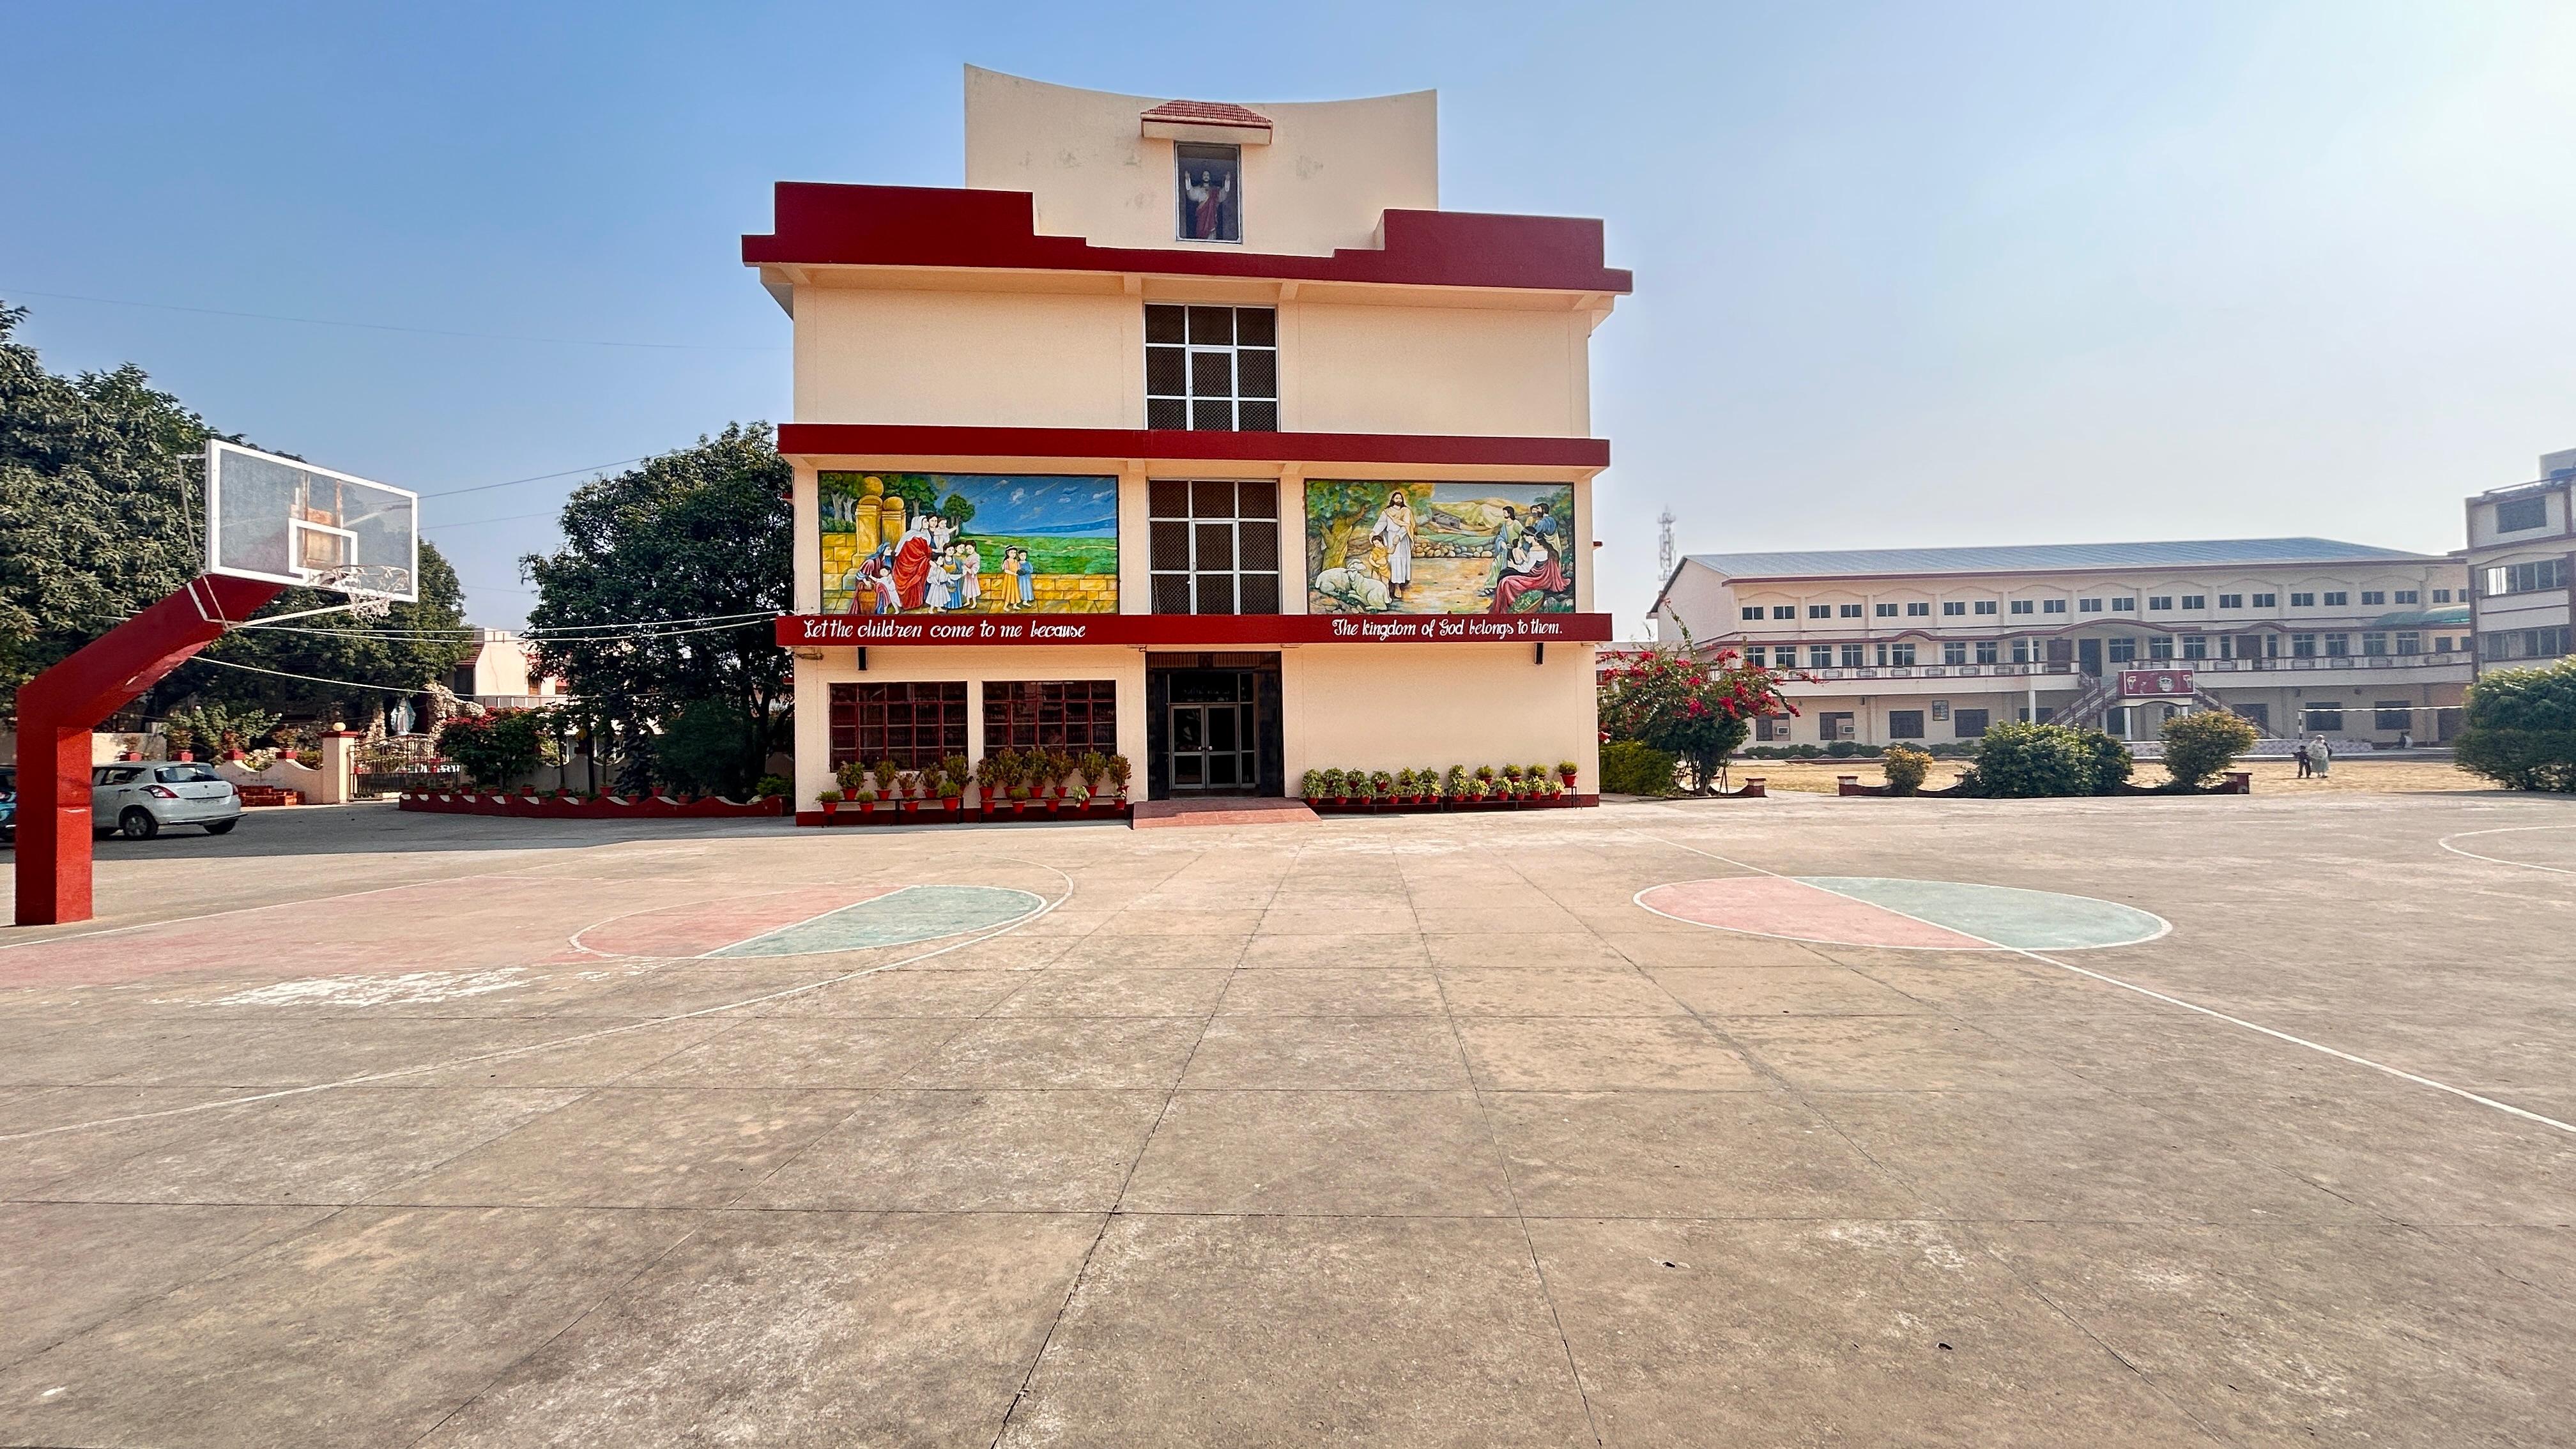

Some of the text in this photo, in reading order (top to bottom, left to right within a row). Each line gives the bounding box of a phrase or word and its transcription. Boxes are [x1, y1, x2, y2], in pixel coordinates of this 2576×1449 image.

[804, 620, 1085, 638] Let the children come to me because
[1332, 618, 1563, 641] The kingdom of God belongs to them.
